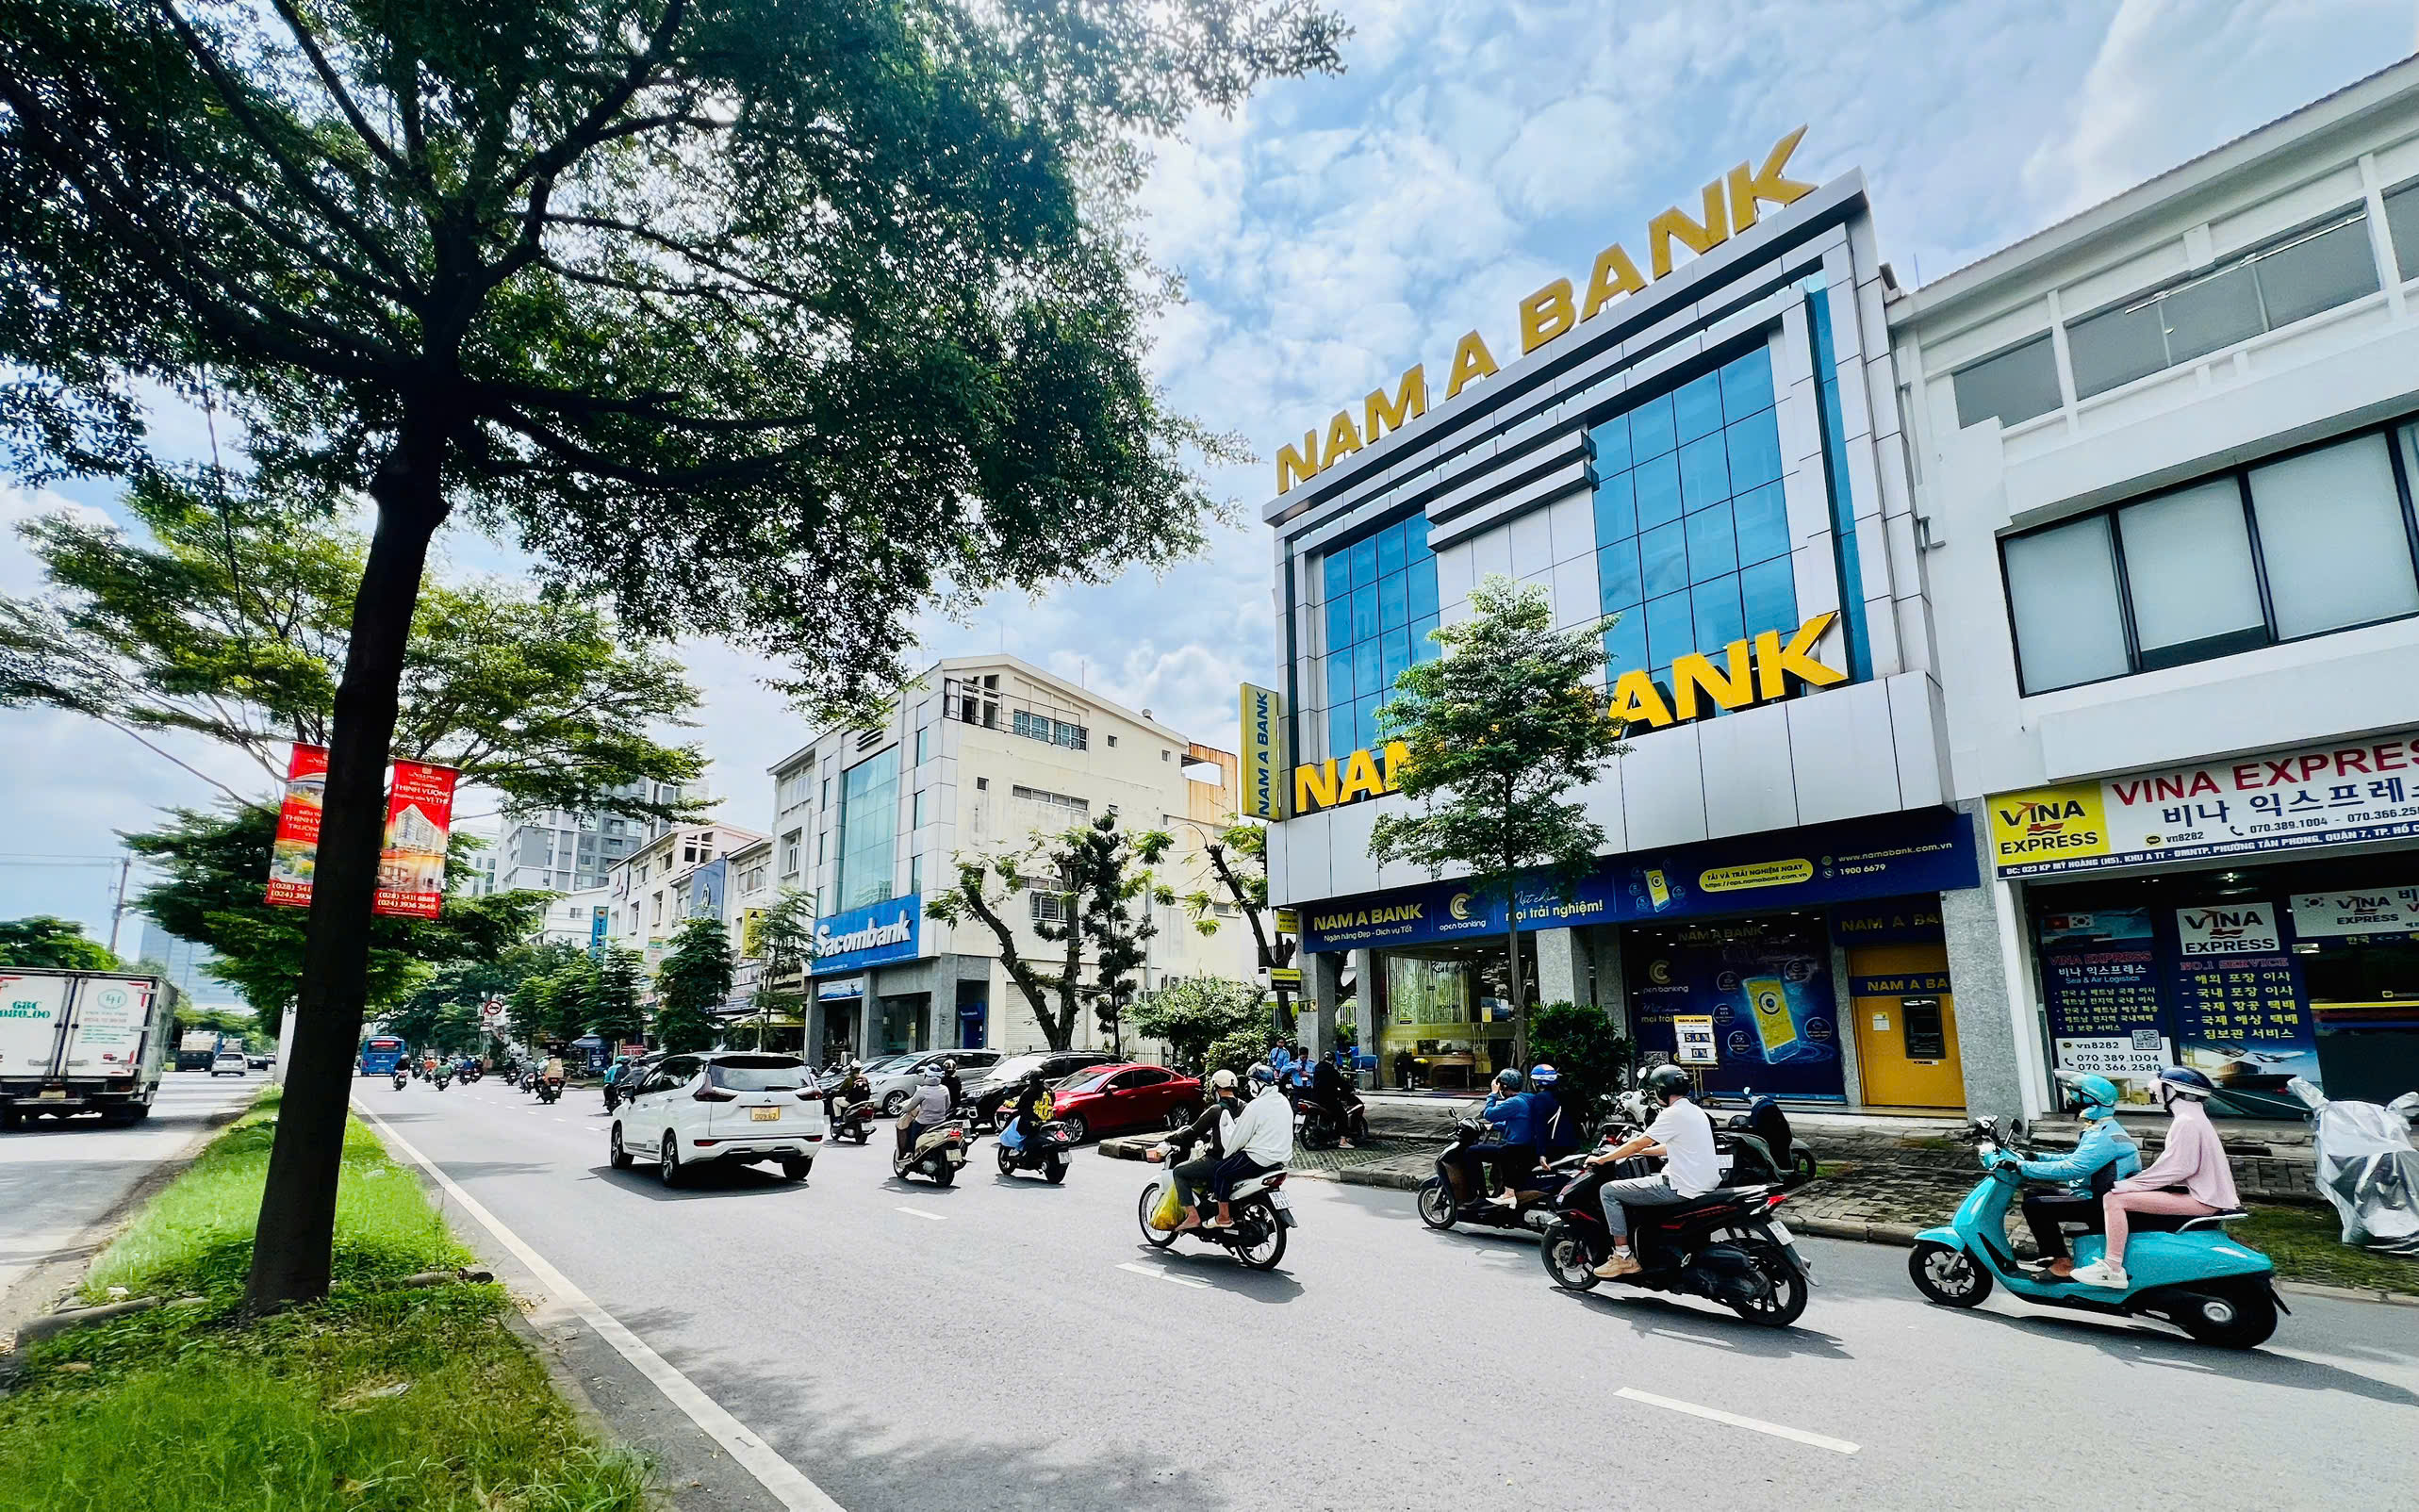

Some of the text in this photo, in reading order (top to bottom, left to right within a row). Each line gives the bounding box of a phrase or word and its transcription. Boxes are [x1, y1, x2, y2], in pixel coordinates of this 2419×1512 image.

[1275, 123, 1819, 495] NAM A BANK
[1567, 611, 1849, 737] ANK
[1257, 691, 1270, 815] NAM A BANK
[2111, 770, 2221, 806] VINA
[2162, 777, 2419, 828] 비나 익스프레
[1999, 800, 2086, 827] VINA
[2249, 817, 2328, 834] 070.389.1004
[2000, 831, 2098, 855] EXPRESS
[2166, 830, 2205, 843] vn8282
[1838, 842, 1953, 863] www.namabank.com.vn
[2124, 853, 2144, 863] KHU
[2146, 852, 2153, 861] A
[2257, 838, 2279, 848] TÂN
[2325, 830, 2358, 842] QUẬN
[1750, 866, 1780, 876] NGHIỆM
[1781, 863, 1803, 872] NGAY
[1839, 863, 1886, 876] 1900 6679
[272, 881, 295, 891] (028)
[271, 890, 293, 898] (024)
[1529, 899, 1604, 920] trải nghiệm!
[2336, 896, 2391, 910] VINA
[1313, 912, 1353, 931] NAM
[1356, 910, 1368, 927] A
[1371, 902, 1424, 923] BANK
[2184, 911, 2264, 930] VINA
[2336, 913, 2399, 925] EXPRESS
[1439, 919, 1487, 932] open banking
[1841, 917, 1884, 931] NAM
[814, 909, 912, 958] Sacombank
[1324, 933, 1341, 943] Ngân
[1341, 930, 1357, 941] hàng
[1358, 929, 1371, 940] Đẹp
[1391, 927, 1400, 936] vụ
[1400, 925, 1412, 933] Tốt
[1677, 931, 1710, 942] NAM
[1724, 926, 1765, 939] BANK
[2185, 938, 2277, 953] EXPRESS
[2050, 951, 2153, 965] VINA EXPRESS
[2180, 958, 2290, 971] NO.1 SERVICE
[2058, 964, 2147, 977] 비나 익스프레스
[2195, 971, 2291, 984] 해외 포장 이사
[1867, 980, 1904, 992] NAM
[1910, 978, 1921, 990] A
[2104, 975, 2141, 984] Logistics
[2197, 985, 2294, 998] 국내 포장 이사
[2198, 1001, 2226, 1011] 국제
[2231, 1000, 2260, 1011] 항공
[2201, 1014, 2228, 1026] 국제
[2234, 1014, 2263, 1026] 해상
[2251, 1028, 2295, 1039] 서비스
[2076, 1054, 2159, 1062] 070.389.1004
